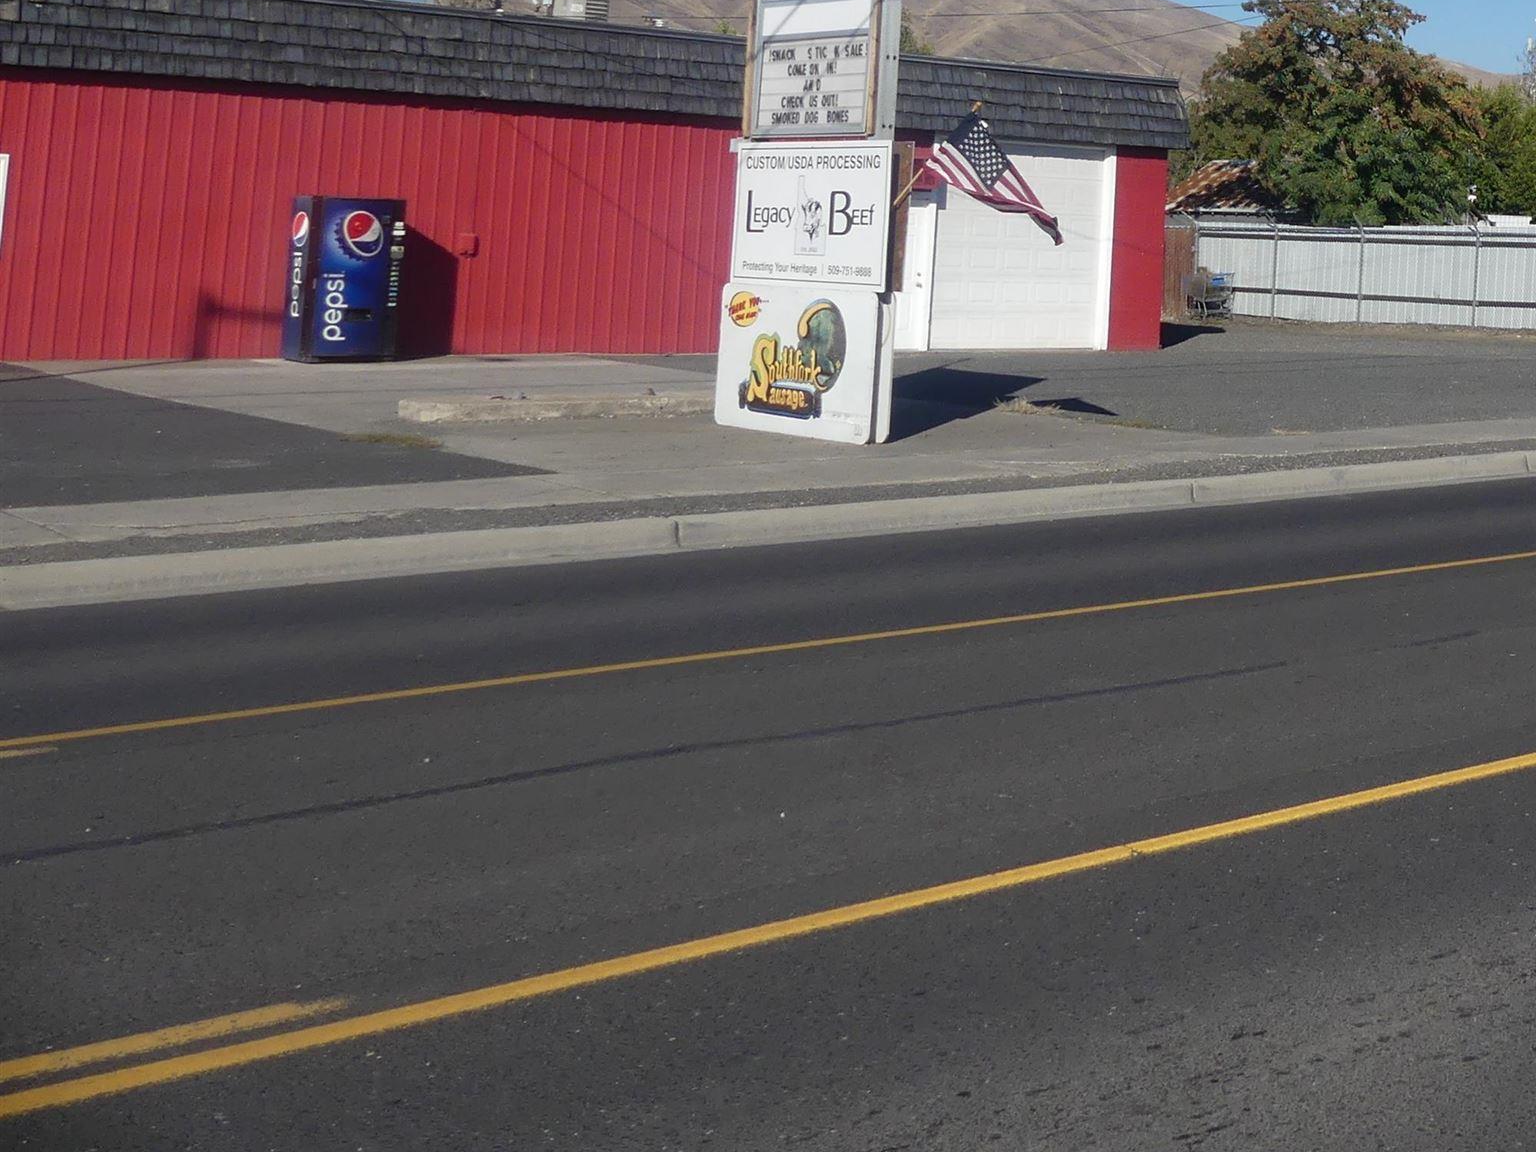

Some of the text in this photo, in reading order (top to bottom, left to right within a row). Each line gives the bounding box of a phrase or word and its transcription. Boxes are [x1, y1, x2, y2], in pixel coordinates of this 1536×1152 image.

[787, 61, 837, 76] COME ON IN!
[803, 79, 821, 92] AND
[781, 94, 838, 108] CHECK US OUT!
[771, 110, 849, 124] SMOKED DOG BONES
[746, 155, 881, 170] CUSTOM USDA PROCESSING
[743, 261, 773, 274] Protecting
[775, 262, 789, 272] Your
[790, 264, 817, 276] Heritage
